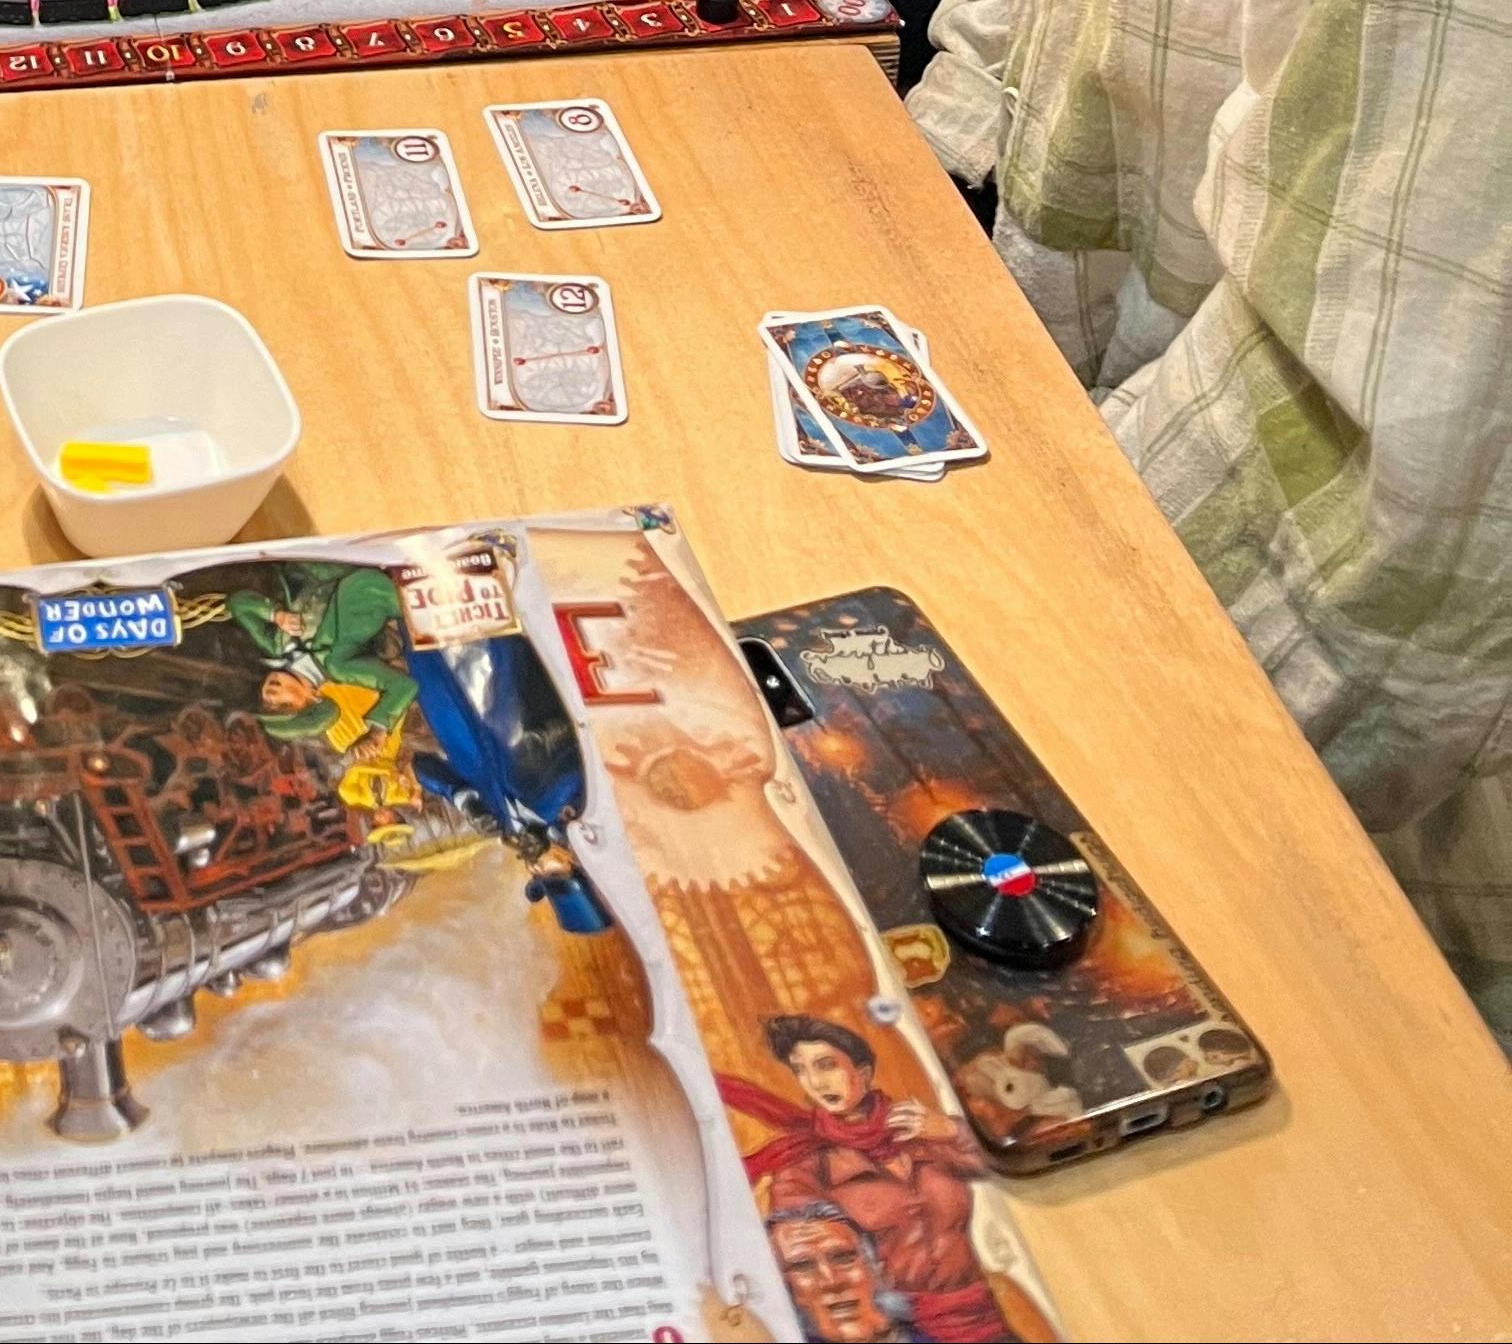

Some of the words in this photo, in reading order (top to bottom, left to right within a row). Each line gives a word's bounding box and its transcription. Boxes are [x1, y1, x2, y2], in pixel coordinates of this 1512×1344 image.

[433, 27, 455, 41] 6
[502, 21, 524, 38] 5
[225, 41, 246, 56] 9
[295, 36, 316, 50] 8
[84, 50, 107, 65] 11
[146, 44, 181, 62] 10
[9, 55, 39, 71] 12
[569, 114, 590, 126] 8
[403, 143, 428, 158] 11
[561, 286, 586, 312] 12
[406, 578, 474, 608] RDE
[480, 585, 502, 598] TO
[44, 592, 165, 621] WONDER
[47, 622, 87, 644] OF
[94, 617, 166, 639] DAYS
